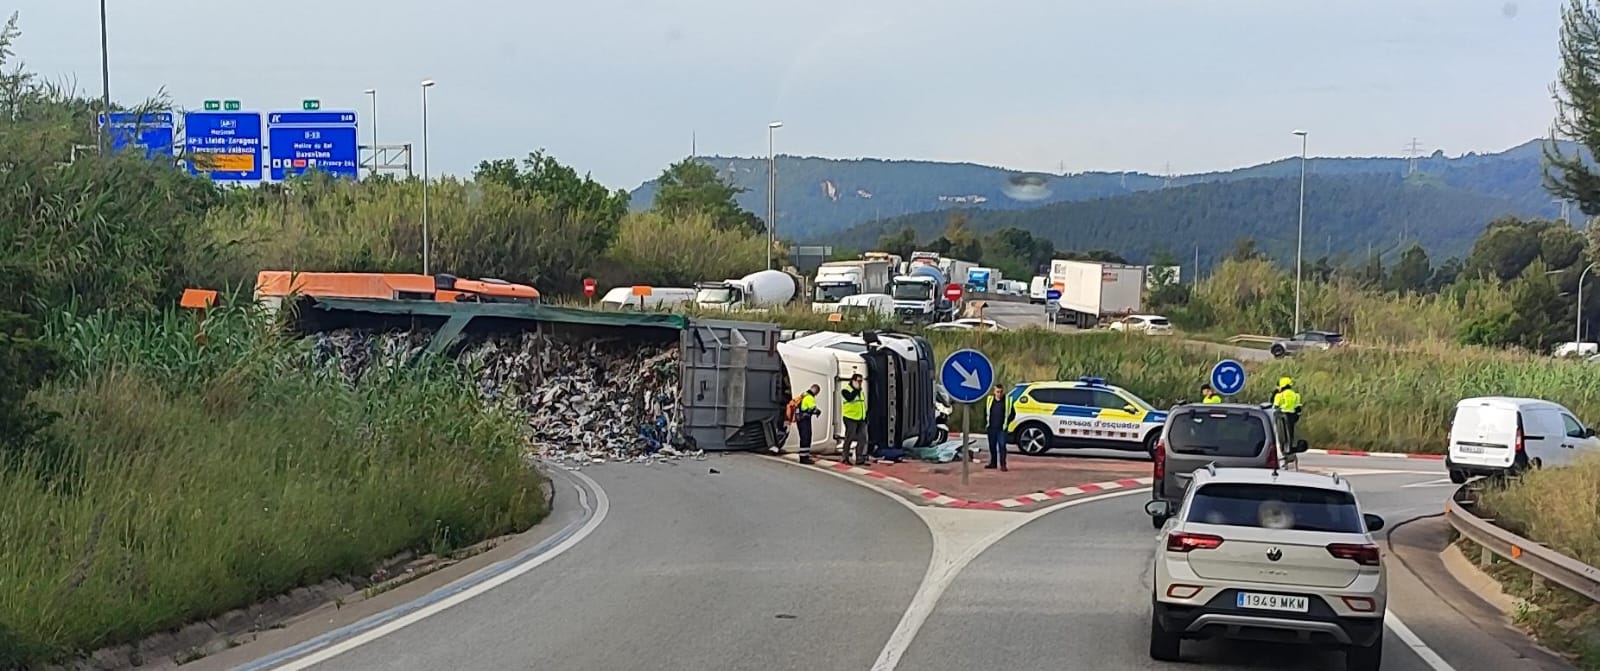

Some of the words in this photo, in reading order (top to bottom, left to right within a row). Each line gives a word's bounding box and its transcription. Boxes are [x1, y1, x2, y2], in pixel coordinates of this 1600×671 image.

[1059, 419, 1092, 427] mossos
[1094, 420, 1140, 429] d'esquadra
[1247, 595, 1277, 607] 1949
[1280, 597, 1304, 609] MKM
